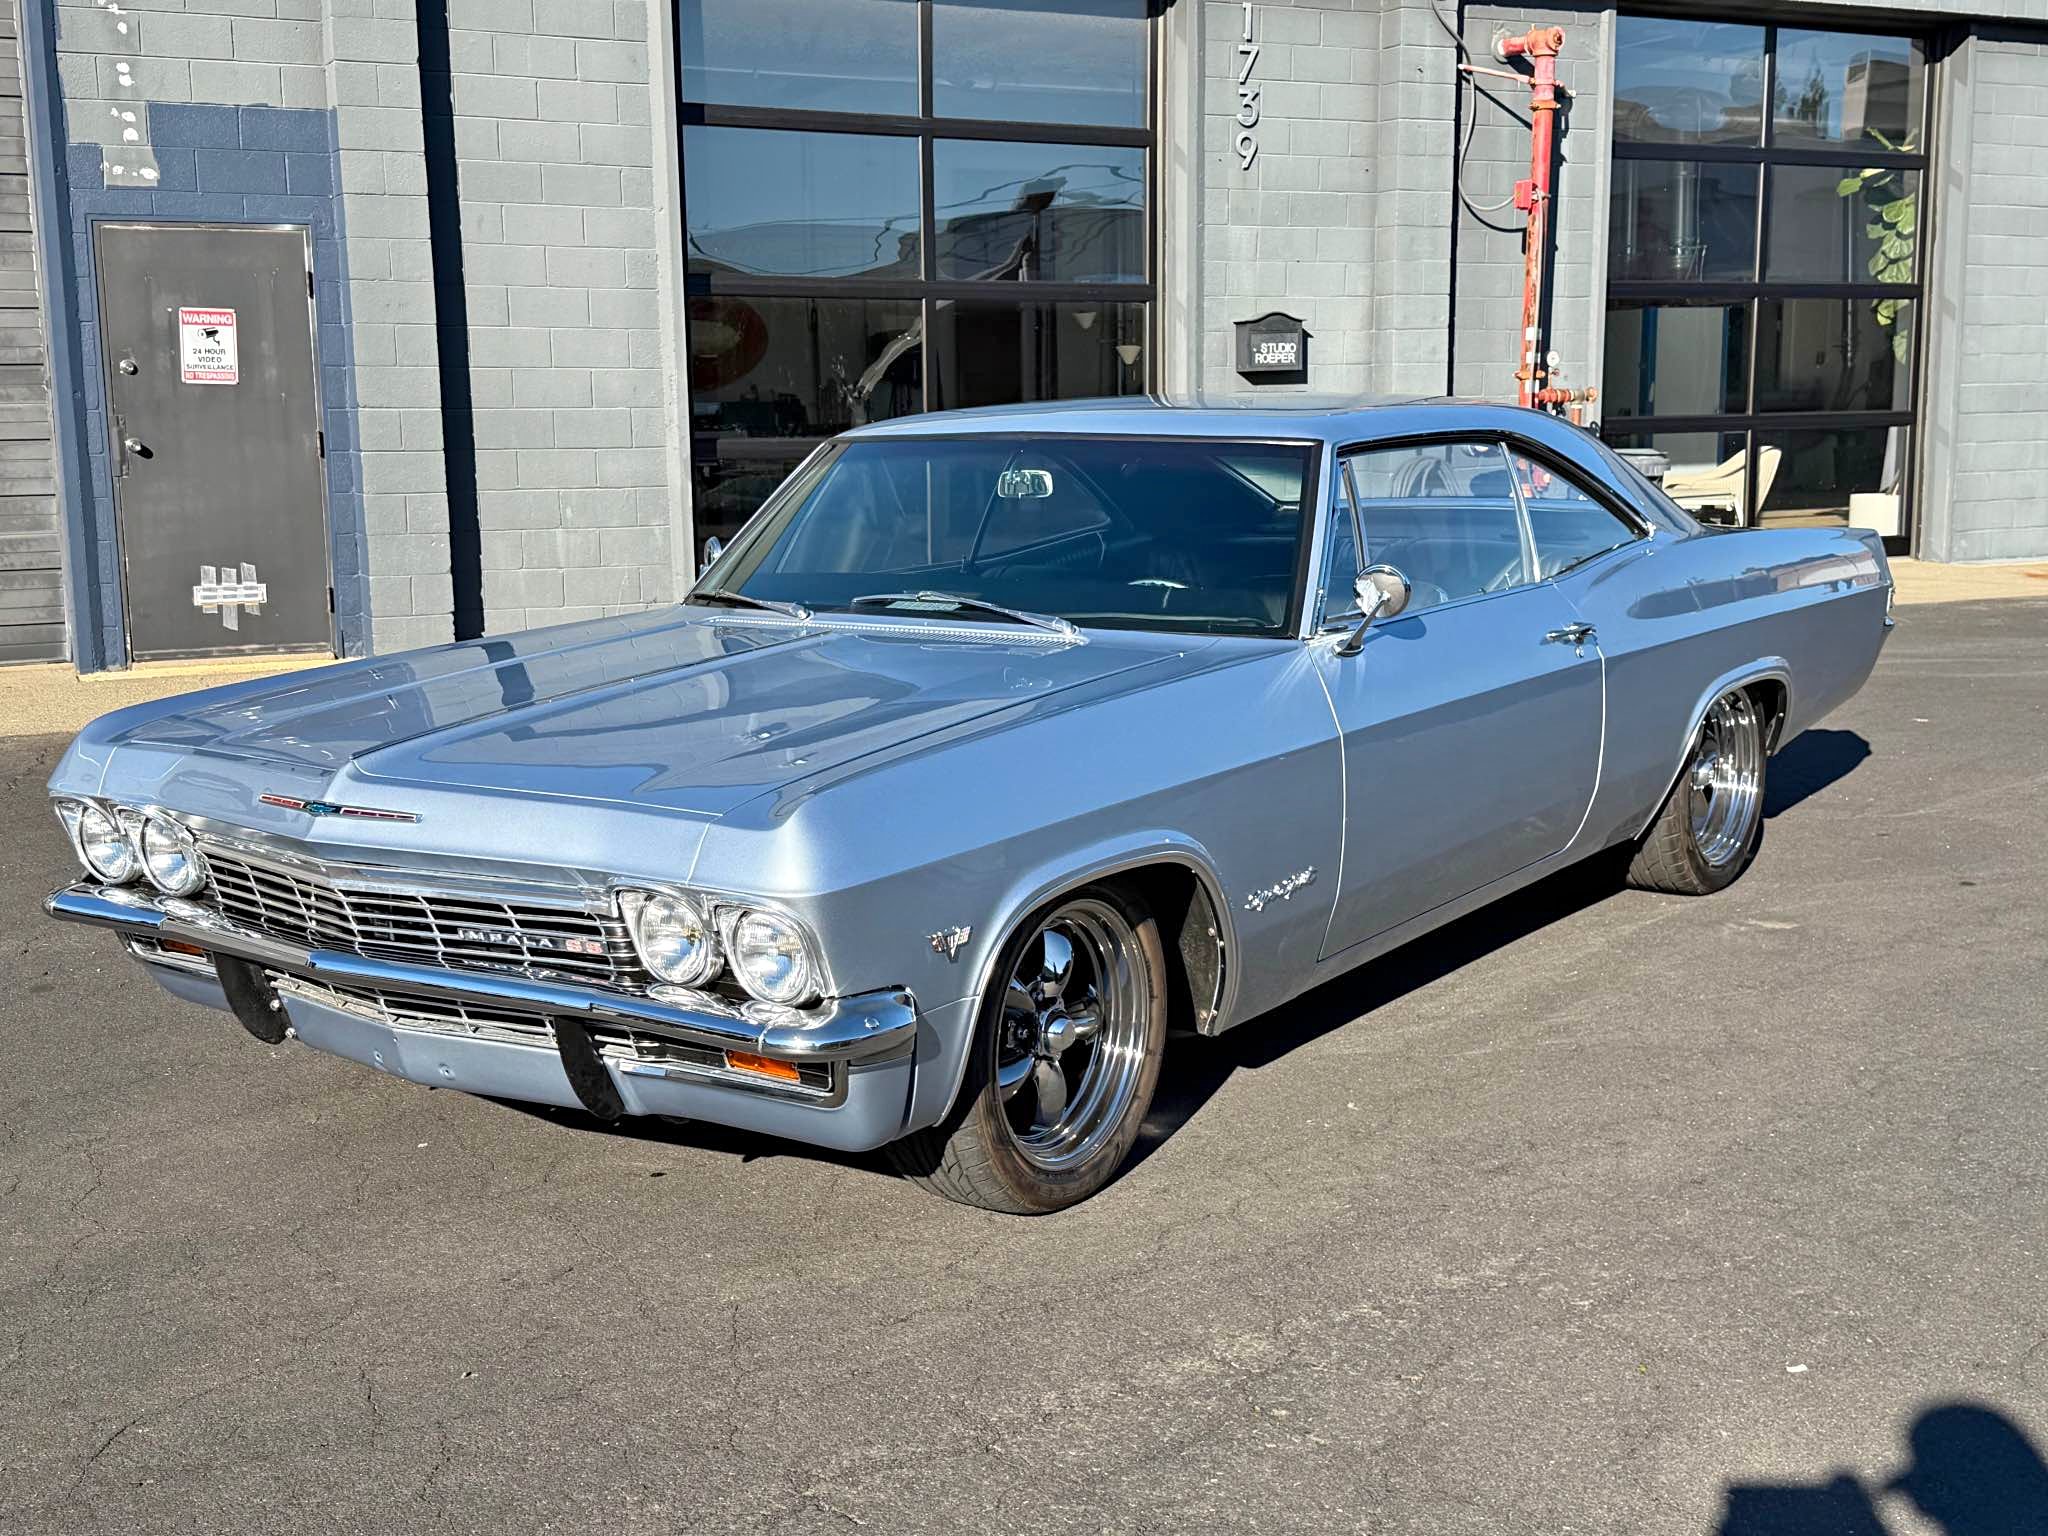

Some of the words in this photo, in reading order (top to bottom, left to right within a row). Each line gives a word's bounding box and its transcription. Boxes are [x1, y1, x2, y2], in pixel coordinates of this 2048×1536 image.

[1235, 2, 1259, 171] 1739
[183, 313, 233, 325] WARNING
[204, 348, 226, 356] HOUR
[1260, 342, 1297, 353] STUDIO
[1255, 352, 1296, 364] ROEPER
[457, 928, 554, 948] IMPALA
[564, 937, 604, 955] SS
